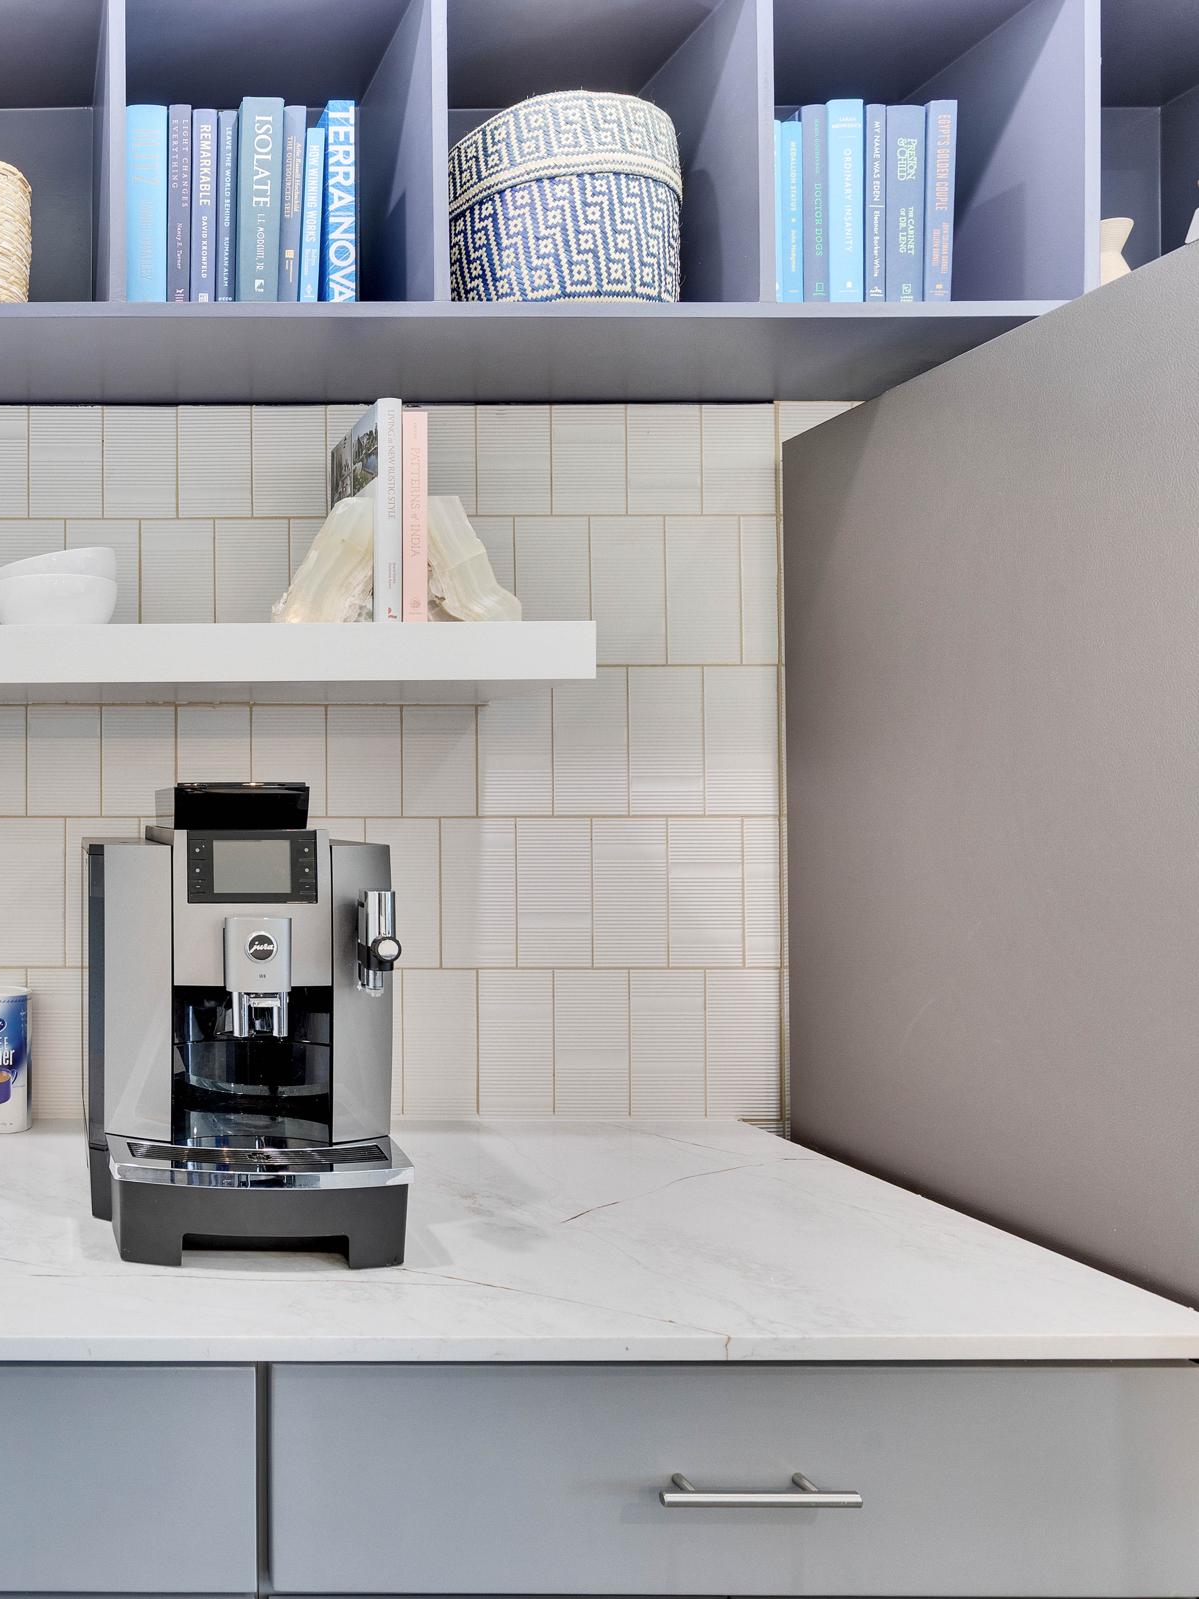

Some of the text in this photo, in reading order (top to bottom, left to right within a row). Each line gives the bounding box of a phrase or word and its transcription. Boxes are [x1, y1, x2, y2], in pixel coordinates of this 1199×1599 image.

[873, 121, 880, 132] MY
[171, 119, 179, 189] EVERYTHING
[199, 124, 212, 206] REMARKABLE
[252, 115, 272, 207] ISOLATE
[308, 145, 319, 166] HOW
[906, 138, 918, 181] PRESTON
[935, 114, 951, 211] EGYPT'S GOLDEN COUPLE
[285, 152, 293, 200] OUTSOURCED
[306, 167, 318, 208] WINNING
[843, 148, 853, 253] ORDINARY INSANITY
[305, 210, 317, 243] WORKS
[815, 228, 823, 257] DOGS
[907, 219, 915, 255] CABINET
[410, 447, 420, 510] PATTERNS
[387, 495, 395, 520] STYLE
[410, 524, 420, 558] INDIA
[249, 941, 274, 953] jura
